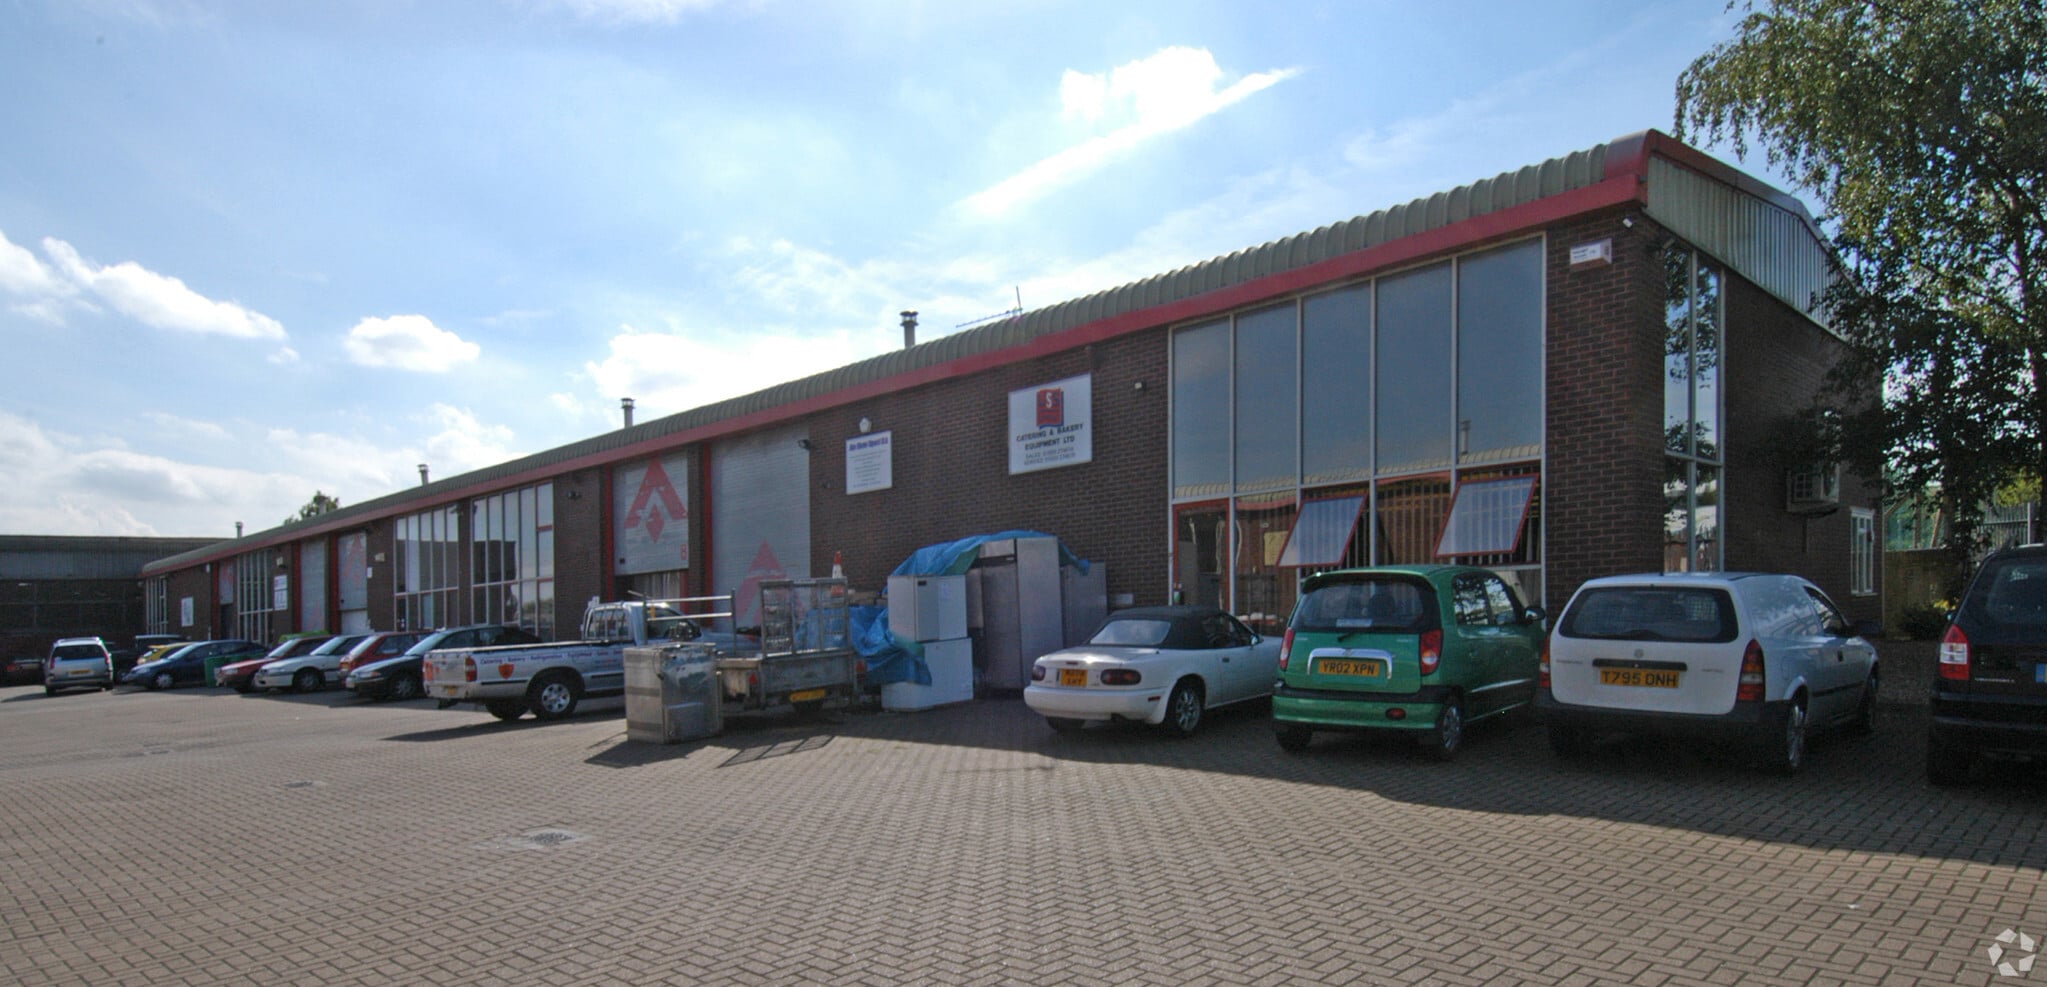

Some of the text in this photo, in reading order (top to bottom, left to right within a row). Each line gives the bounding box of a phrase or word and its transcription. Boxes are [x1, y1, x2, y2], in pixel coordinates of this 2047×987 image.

[1016, 430, 1047, 442] CATERING
[1057, 422, 1084, 434] BAKERY
[1025, 435, 1075, 450] EQUIPMENT LTD
[1323, 661, 1376, 675] YR02 XPN
[1602, 670, 1641, 685] T795
